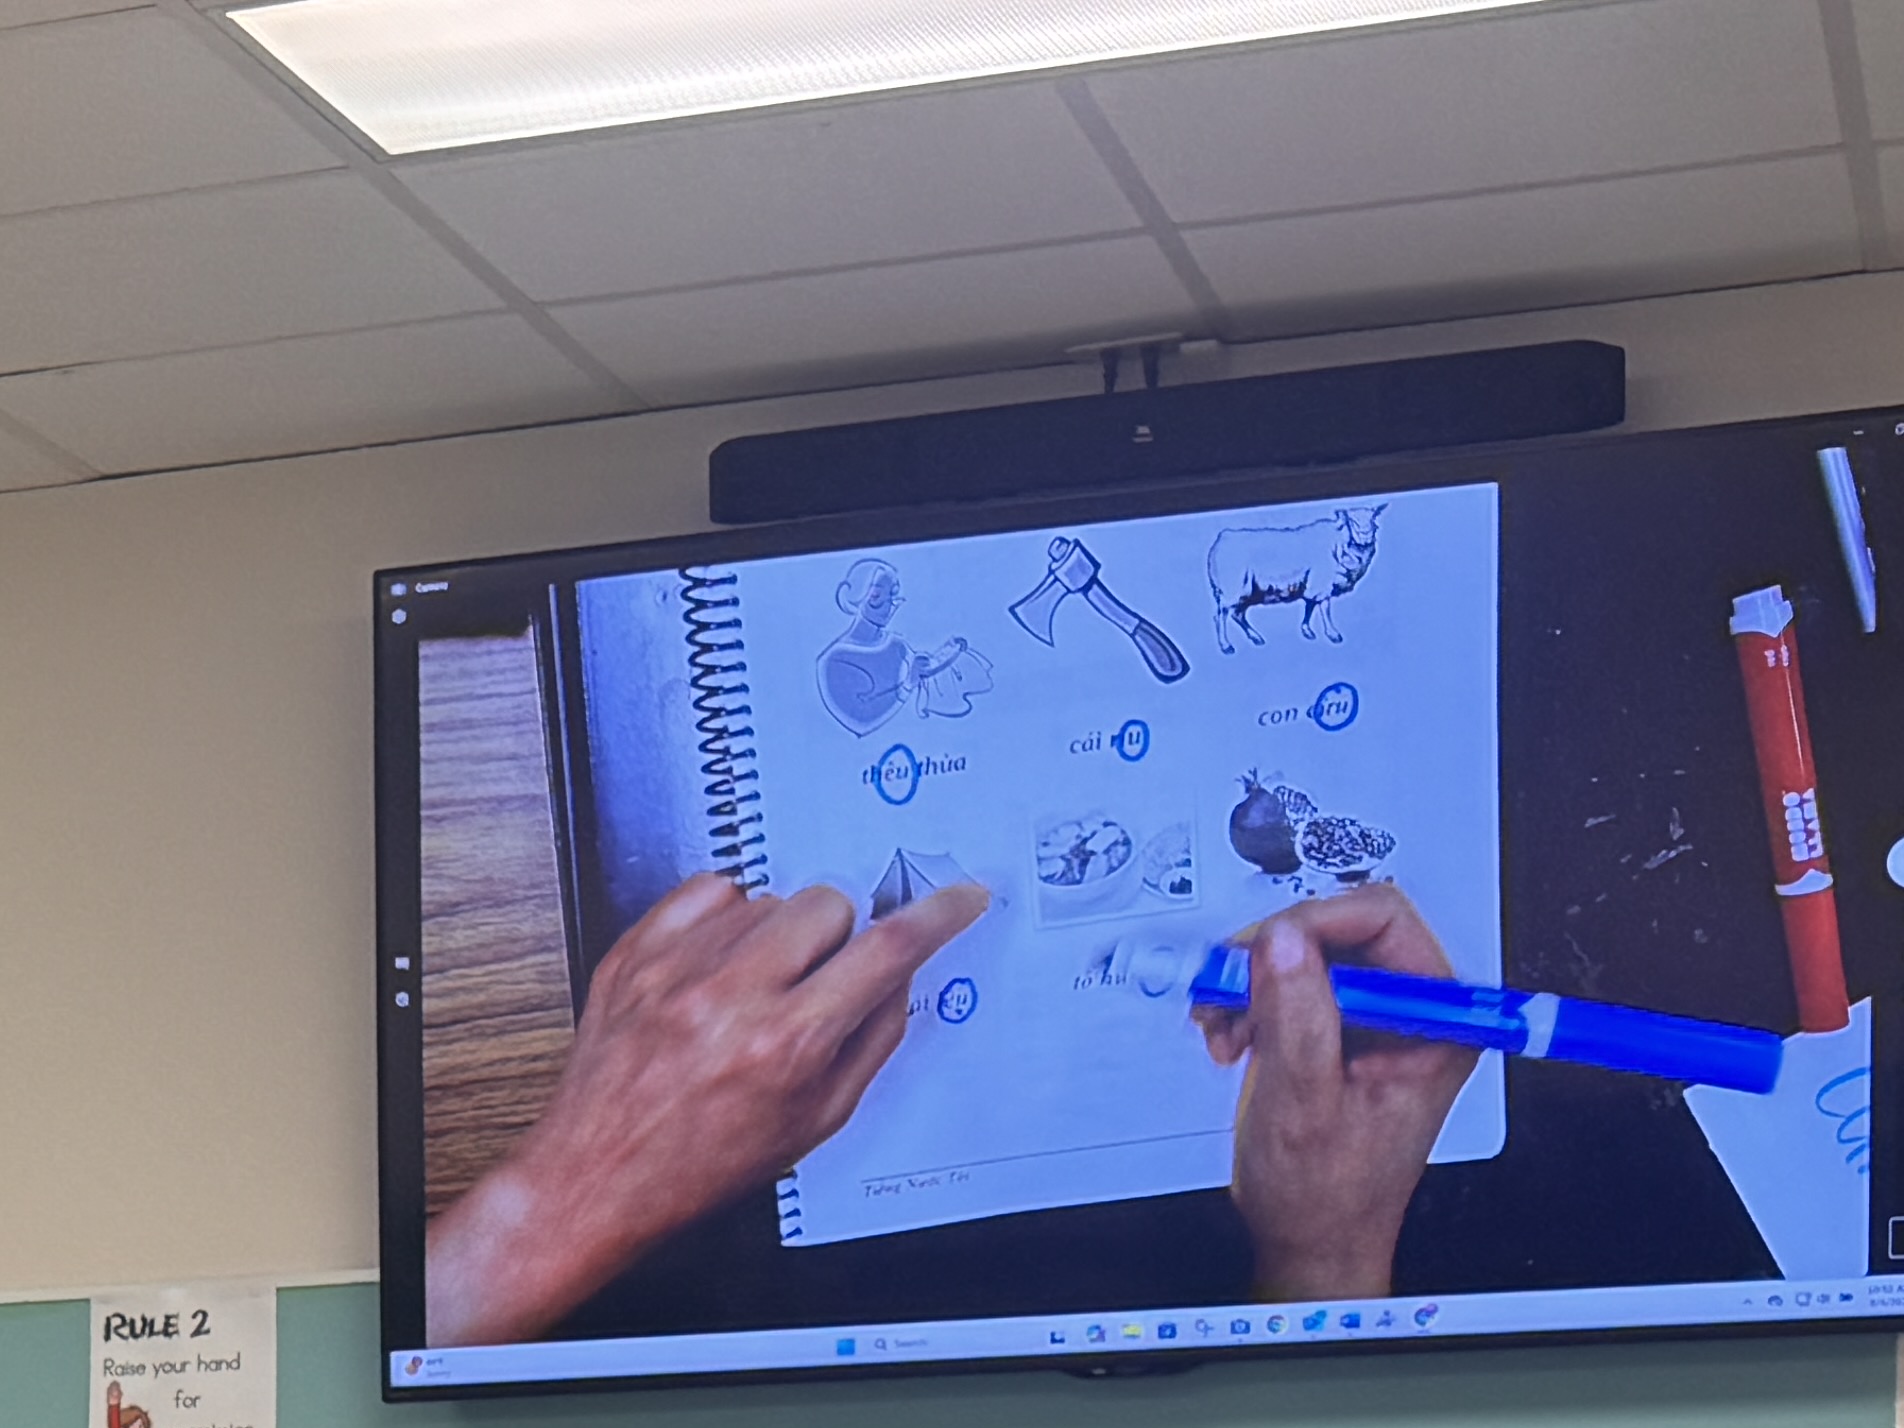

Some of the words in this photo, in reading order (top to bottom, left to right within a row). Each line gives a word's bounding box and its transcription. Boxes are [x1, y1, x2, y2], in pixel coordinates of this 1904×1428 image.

[1258, 706, 1298, 726] con
[1069, 731, 1102, 754] cái
[862, 760, 909, 786] thêu
[916, 752, 967, 778] thùa
[103, 1312, 180, 1343] RULE
[189, 1309, 212, 1338] 2
[103, 1357, 147, 1377] Raise
[152, 1360, 190, 1379] your
[196, 1351, 241, 1372] hand
[174, 1389, 201, 1409] for
